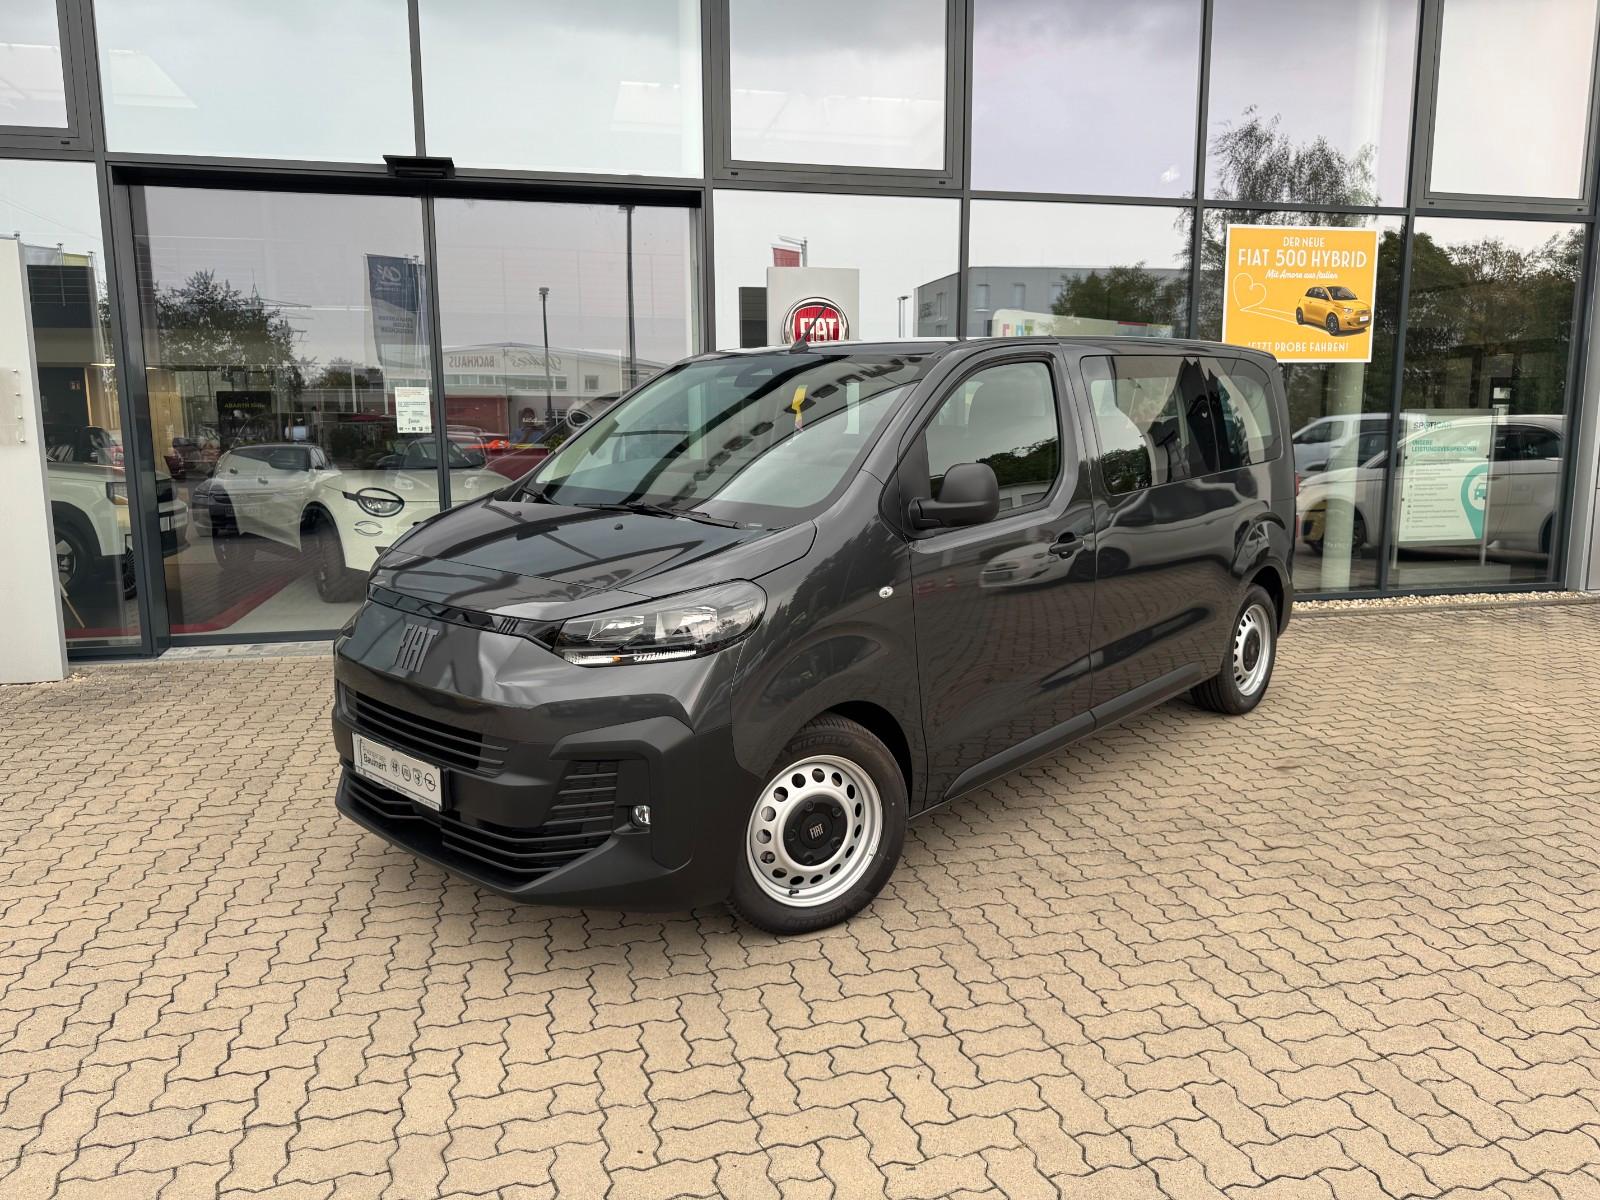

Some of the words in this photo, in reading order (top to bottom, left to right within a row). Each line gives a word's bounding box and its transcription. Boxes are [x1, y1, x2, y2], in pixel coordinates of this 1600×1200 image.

[1283, 236, 1302, 247] DER
[1303, 237, 1326, 248] NEUE
[1238, 248, 1270, 267] FIAT
[1275, 249, 1307, 268] 500
[1311, 250, 1368, 268] HYBRID
[1265, 269, 1279, 279] Mit
[1279, 269, 1303, 279] Amore
[1316, 269, 1339, 279] Italien
[799, 317, 837, 342] FIAT
[1274, 341, 1307, 353] PROBE
[1309, 341, 1349, 353] FAHREN!
[394, 623, 441, 673] FIAT
[809, 823, 824, 840] FIAT
